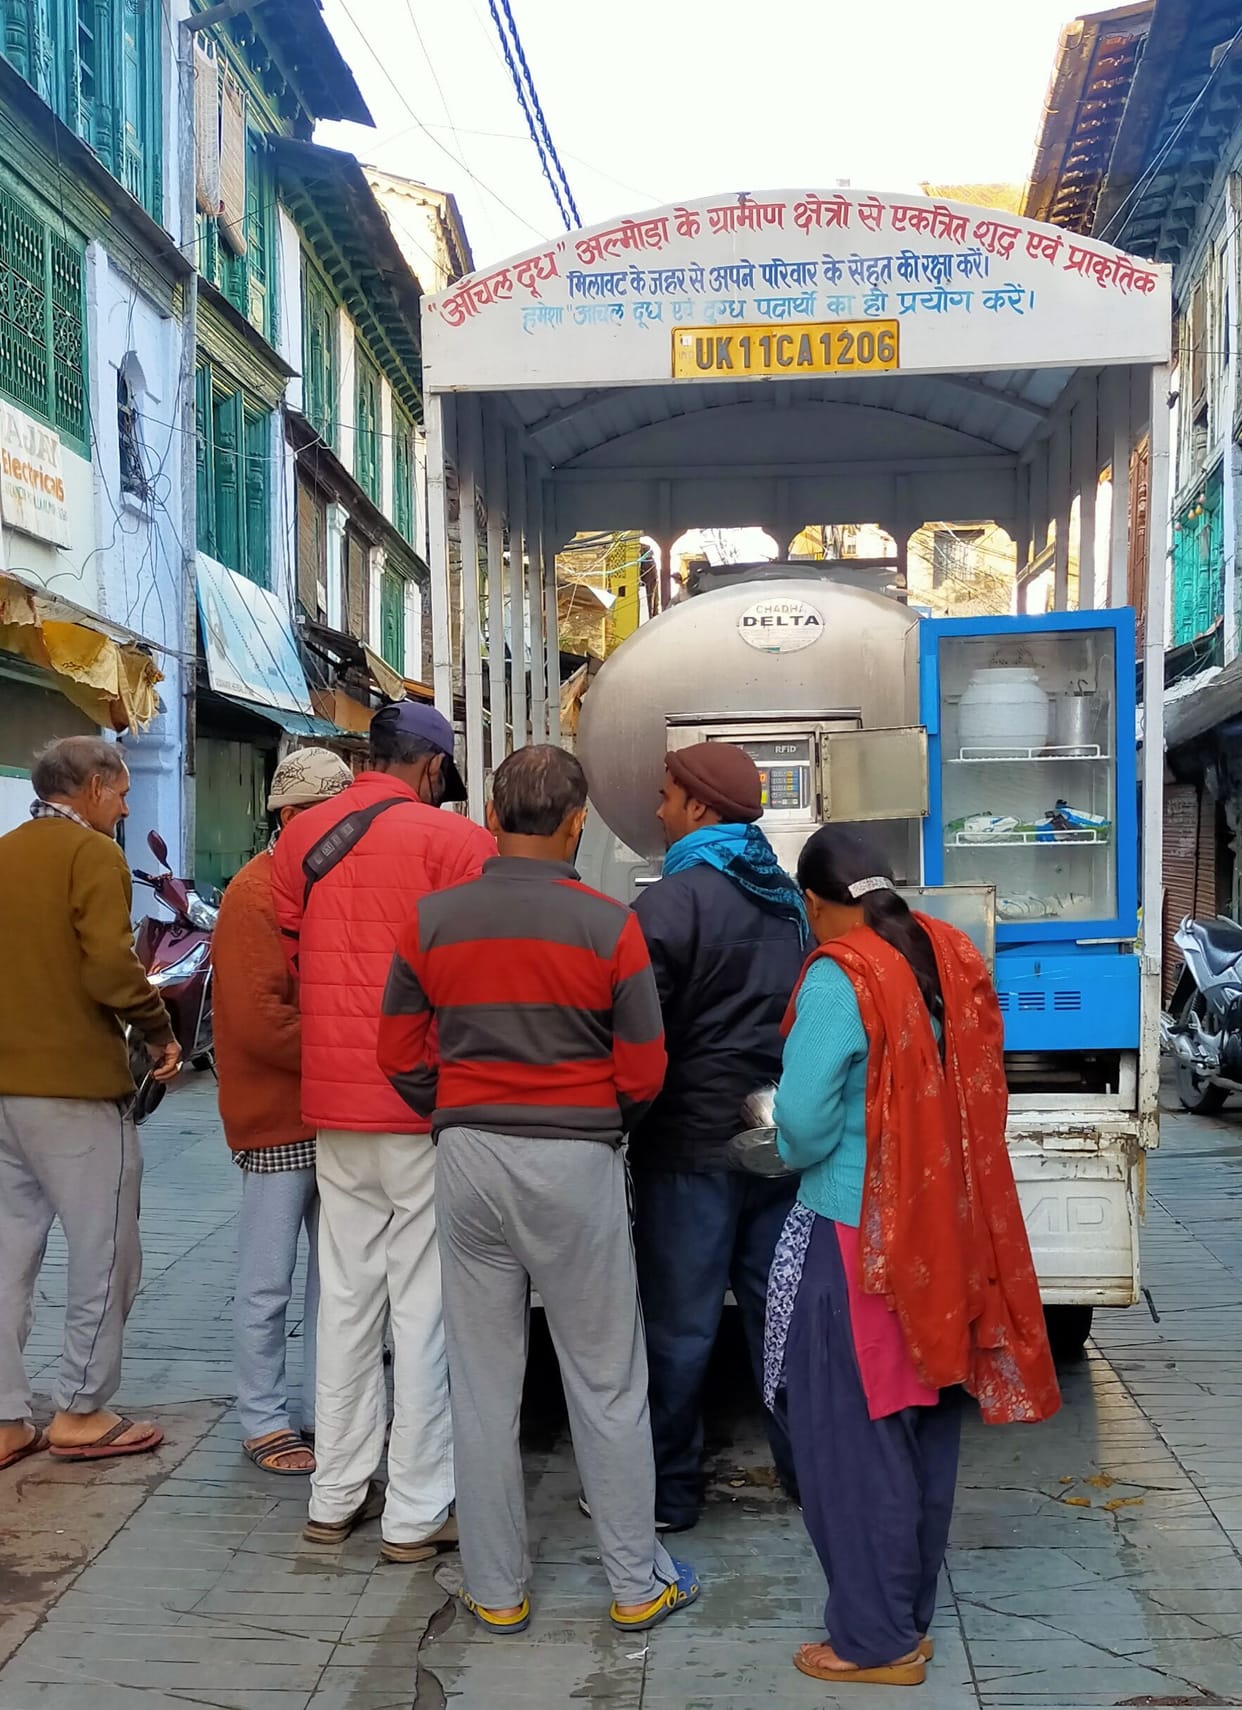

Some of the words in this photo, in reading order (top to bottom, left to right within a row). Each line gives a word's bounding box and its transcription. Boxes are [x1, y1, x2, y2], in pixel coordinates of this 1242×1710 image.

[575, 219, 670, 265] अल्मोड़ा
[673, 207, 701, 240] के
[706, 198, 786, 235] ग्रामीण
[858, 196, 885, 231] से
[890, 204, 970, 245] एकत्रित
[1026, 235, 1065, 266] एवं
[1063, 245, 1158, 297] प्राकृतिक
[566, 270, 628, 300] मिलावट
[629, 264, 647, 294] के
[648, 268, 688, 295] जहर
[688, 262, 705, 293] से
[709, 258, 756, 292] अपने
[759, 258, 818, 289] परिवार
[822, 253, 845, 287] के
[847, 253, 893, 288] सेहत
[896, 249, 920, 284] की
[921, 254, 953, 285] रक्षा
[826, 295, 856, 316] का
[862, 288, 889, 316] ही
[896, 286, 974, 315] प्रयोग
[695, 329, 895, 371] UK11CA1206
[743, 615, 820, 627] DELTA
[775, 745, 797, 754] RFID
